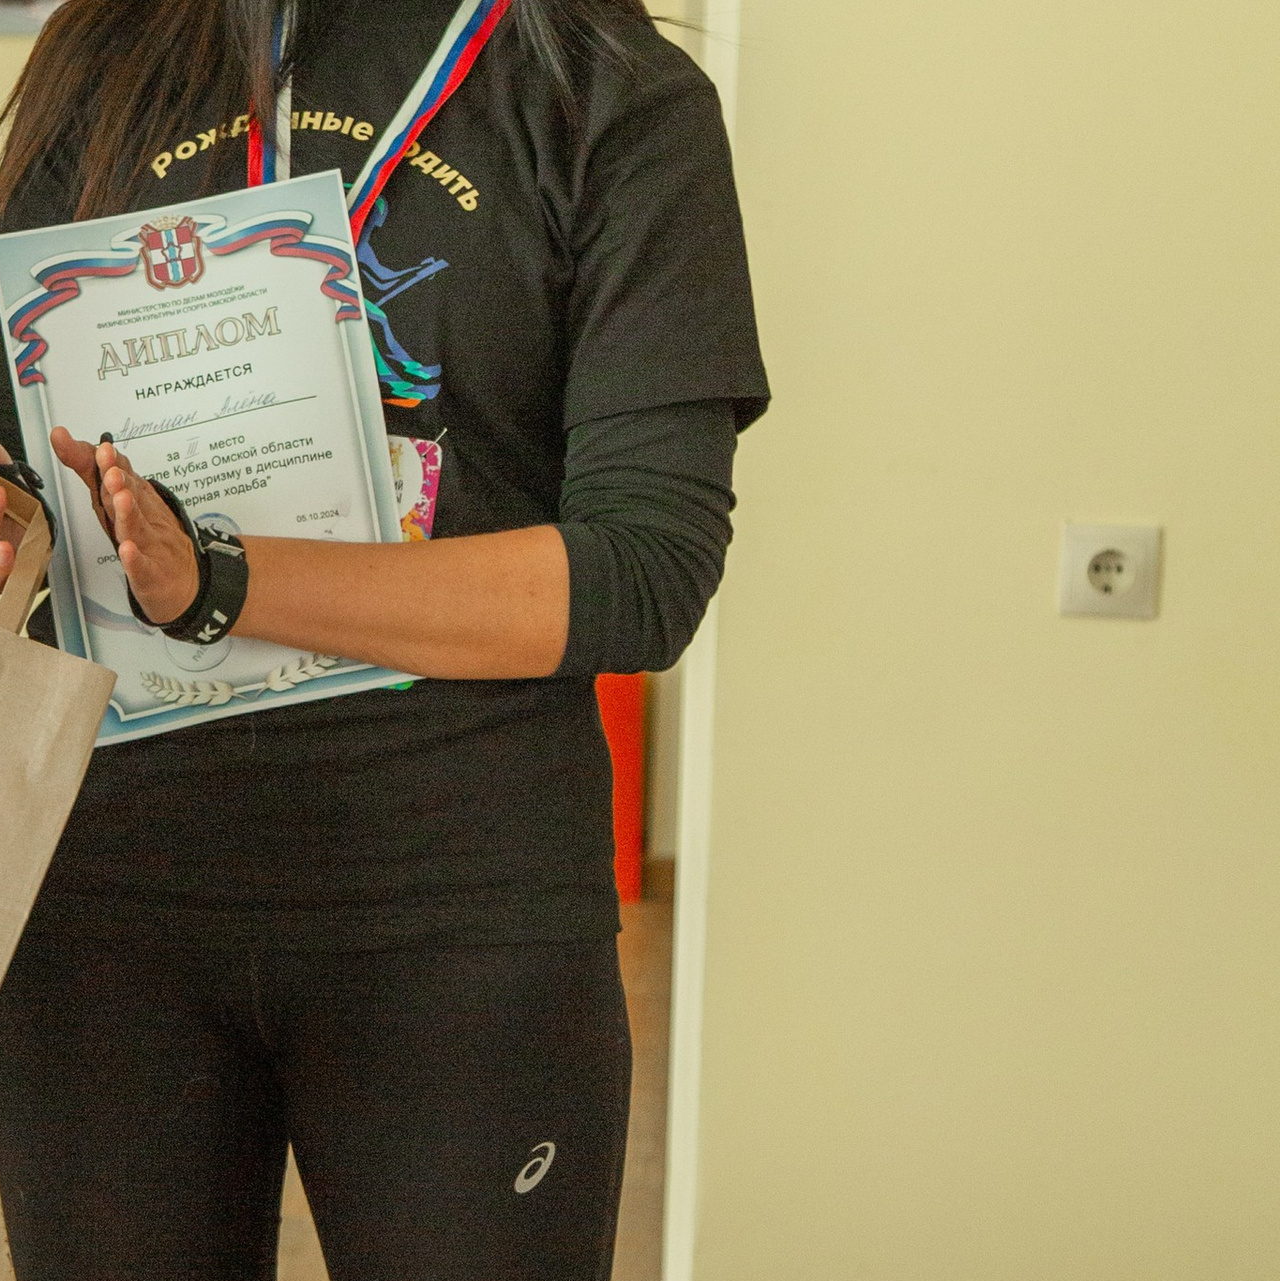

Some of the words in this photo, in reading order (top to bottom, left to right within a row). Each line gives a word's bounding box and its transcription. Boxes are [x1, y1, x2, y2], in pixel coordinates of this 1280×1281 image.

[404, 141, 480, 212] одить
[96, 315, 142, 330] ФИЗИЧЕСКОЙ
[142, 310, 176, 322] КУЛЬТУРЫ
[182, 303, 208, 315] СПОРТА
[208, 295, 237, 307] ОМСКОЙ
[237, 288, 268, 301] ОБЛАСТИ
[117, 301, 171, 317] МИНИСТЕРСТВО
[171, 299, 182, 307] ПО
[182, 294, 207, 306] ДЕЛАМ
[96, 306, 282, 380] ДИПЛОМ
[135, 363, 253, 401] НАГРАЖДАЕТСЯ
[142, 470, 170, 481] тапе
[173, 460, 208, 477] Кубка
[211, 445, 259, 467] Омской
[261, 436, 314, 456] области
[166, 451, 180, 462] за
[209, 435, 246, 452] место
[193, 470, 243, 490] туризму
[245, 466, 254, 476] в
[255, 450, 333, 475] дисциплине
[224, 476, 272, 497] ходьба"
[296, 509, 340, 524] 05.10.2024
